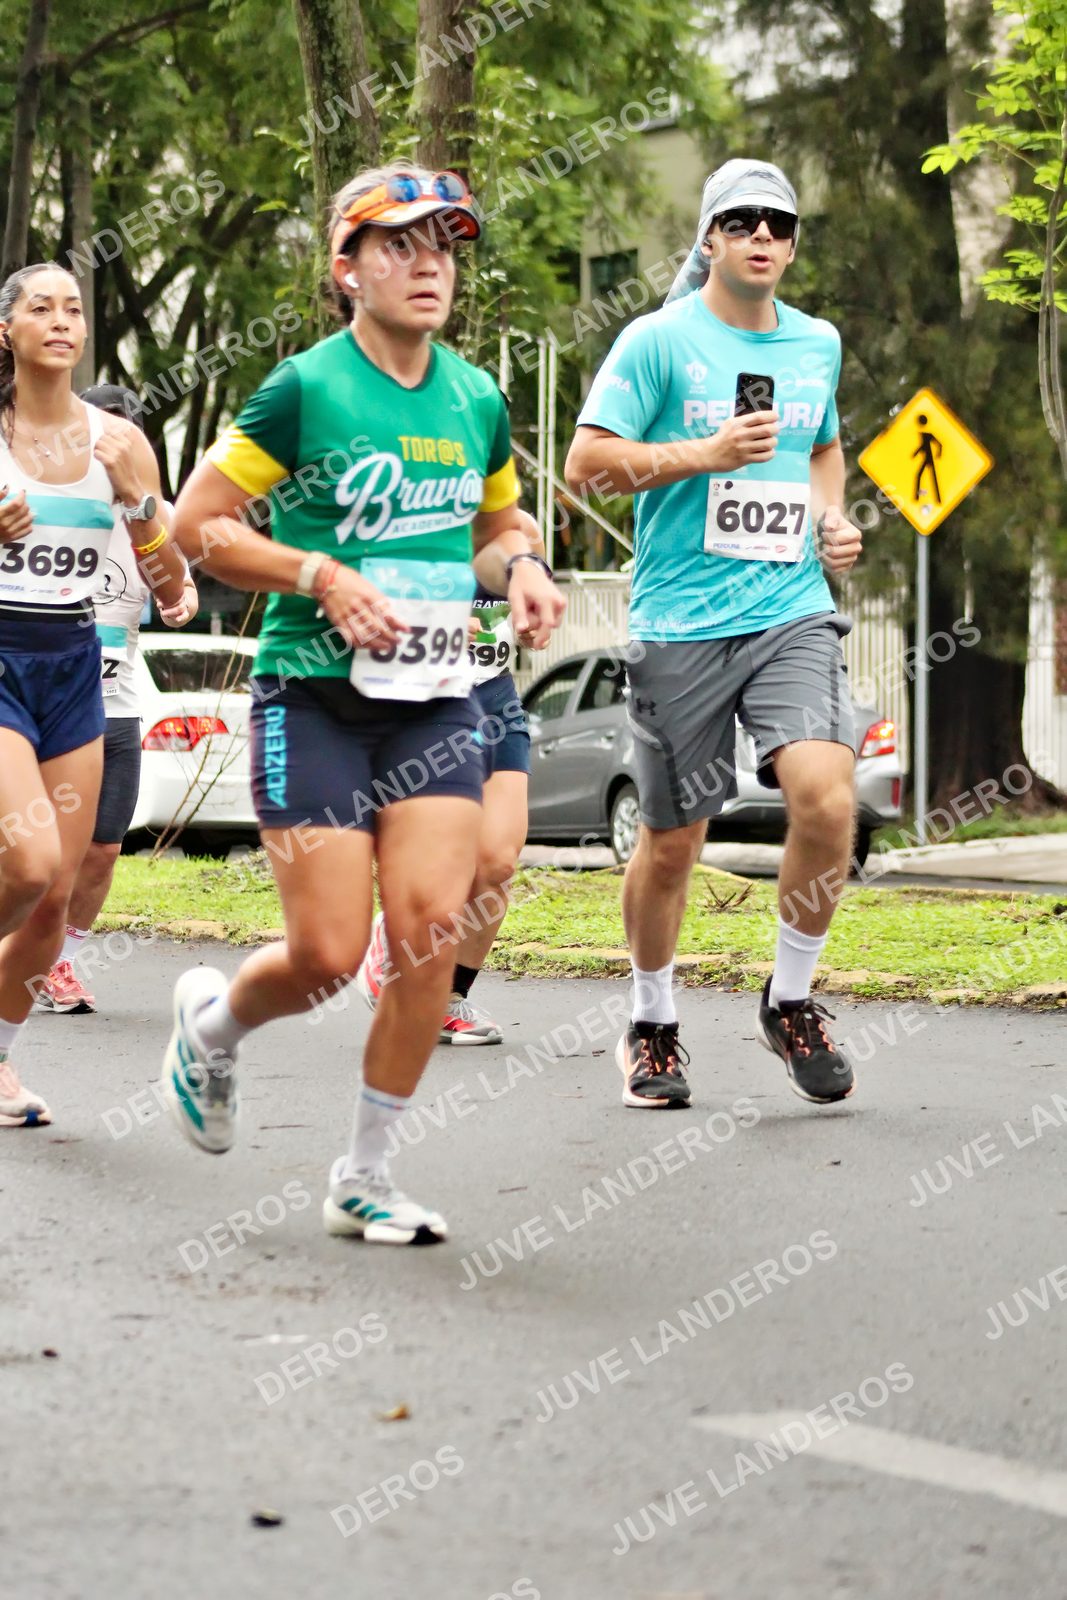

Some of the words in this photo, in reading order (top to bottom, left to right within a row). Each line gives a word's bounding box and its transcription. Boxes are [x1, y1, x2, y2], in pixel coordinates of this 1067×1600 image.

[684, 400, 823, 429] PEURA
[716, 499, 805, 535] 6027
[0, 542, 98, 578] 3699
[264, 705, 287, 808] ADIZERO
